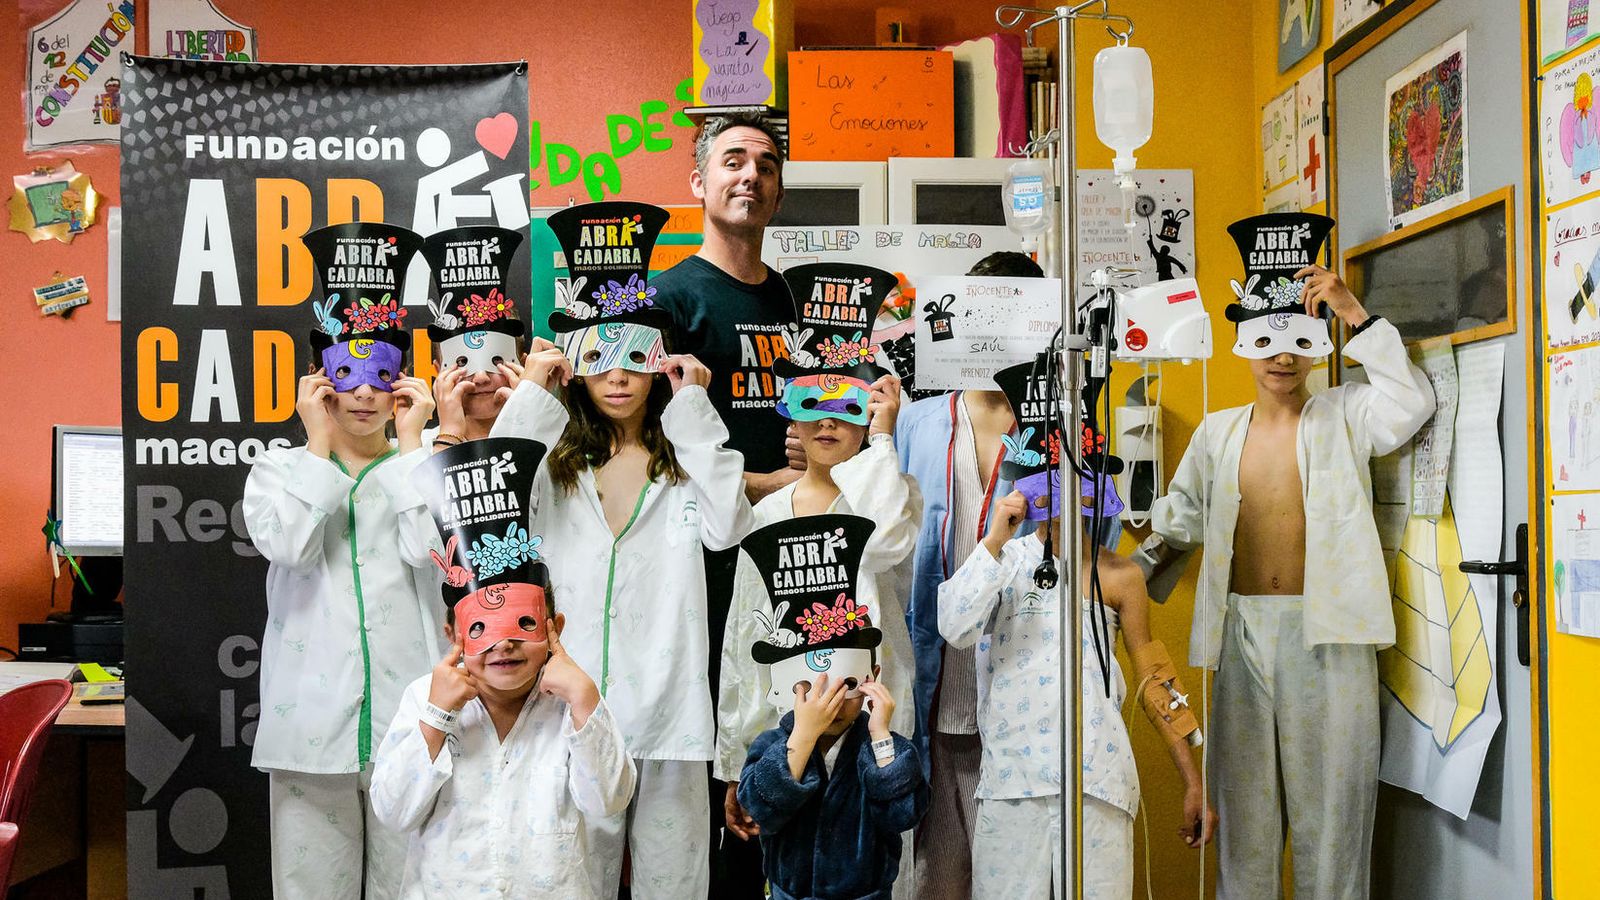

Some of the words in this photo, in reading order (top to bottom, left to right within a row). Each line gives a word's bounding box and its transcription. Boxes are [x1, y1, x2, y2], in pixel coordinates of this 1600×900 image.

[37, 36, 49, 53] 6
[51, 34, 70, 50] del
[166, 30, 246, 55] LIBERTAD
[816, 64, 855, 89] Las
[829, 102, 929, 132] Emociones
[875, 231, 903, 248] DE
[917, 231, 982, 249] MAGIA
[333, 243, 390, 267] ABRA
[445, 246, 494, 267] ABRA
[573, 248, 642, 265] CADABRA
[1249, 250, 1309, 265] CADABRA
[327, 267, 396, 284] CADABRA
[440, 266, 501, 282] CADABRA
[811, 282, 862, 306] ABRA
[803, 302, 867, 322] CADABRA
[444, 463, 508, 501] ABRA
[439, 491, 520, 522] CADABRA
[778, 541, 839, 569] ABRA
[772, 565, 848, 588] CADABRA
